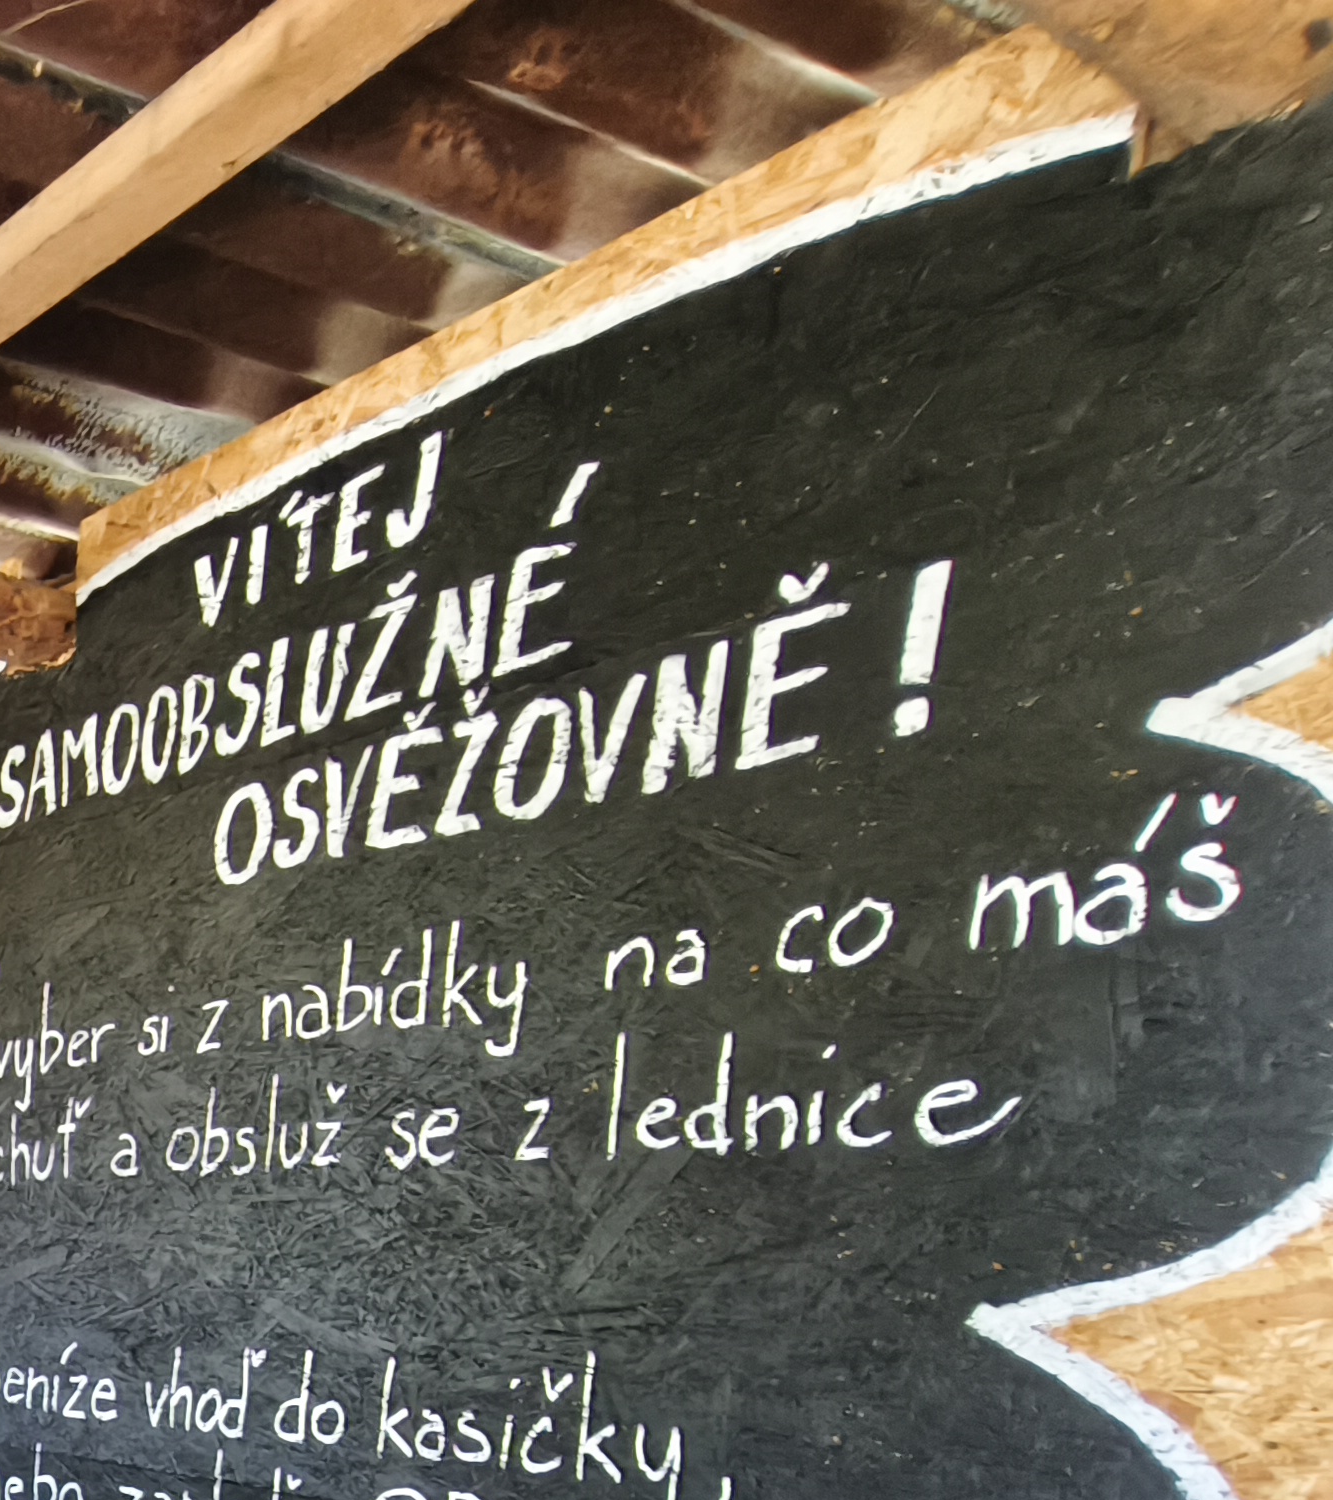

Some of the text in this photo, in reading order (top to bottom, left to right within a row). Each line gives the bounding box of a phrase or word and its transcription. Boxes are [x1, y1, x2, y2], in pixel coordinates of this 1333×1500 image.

[194, 430, 444, 628] VÍTEJ
[137, 985, 173, 1056] si
[197, 999, 229, 1054] z
[262, 920, 526, 1058] nabídky
[604, 929, 706, 990] na
[775, 897, 894, 973] co
[969, 792, 1241, 949] máš
[110, 1133, 139, 1178] a
[165, 1073, 347, 1178] obsluž
[385, 1107, 460, 1171] se
[515, 1097, 550, 1160] z
[607, 1032, 1022, 1160] lednice
[145, 1346, 267, 1439] vhoď
[273, 1349, 347, 1444] do
